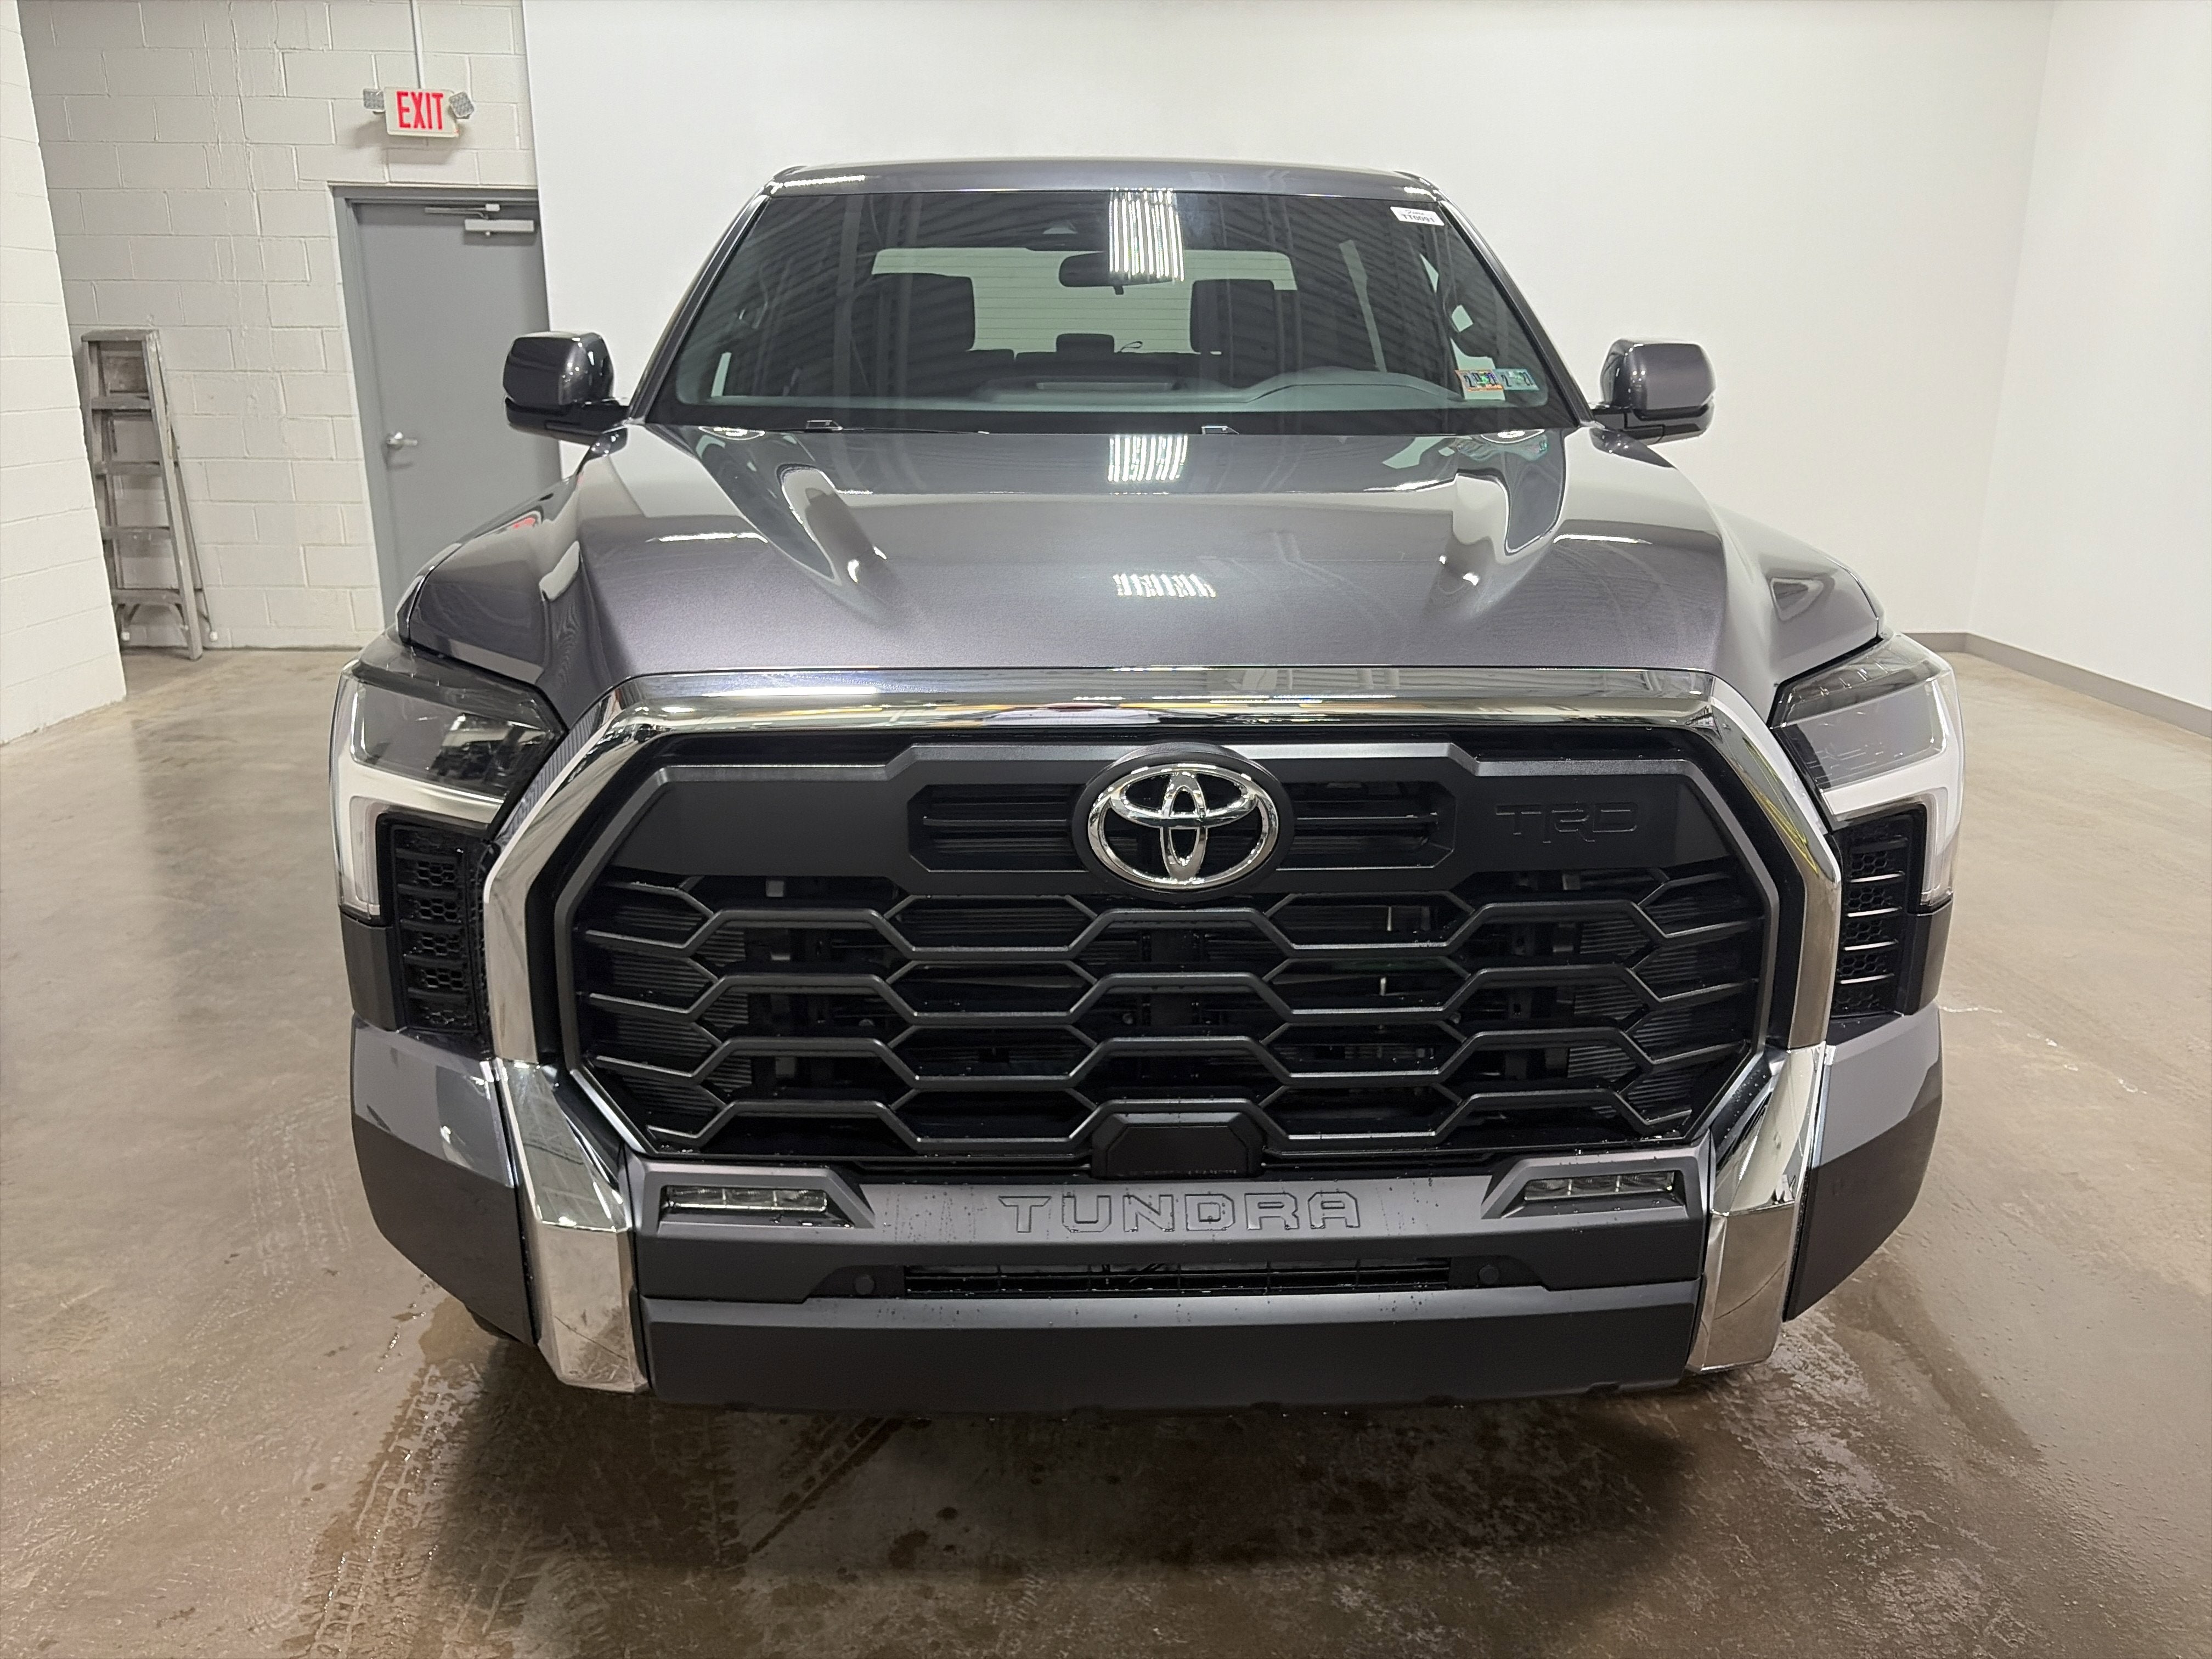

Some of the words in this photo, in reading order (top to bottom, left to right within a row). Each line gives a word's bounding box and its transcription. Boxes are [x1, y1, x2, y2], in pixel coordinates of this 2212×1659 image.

[396, 91, 443, 130] EXIT
[1496, 802, 1638, 844] TRD
[997, 1191, 1361, 1233] TUNDRA
